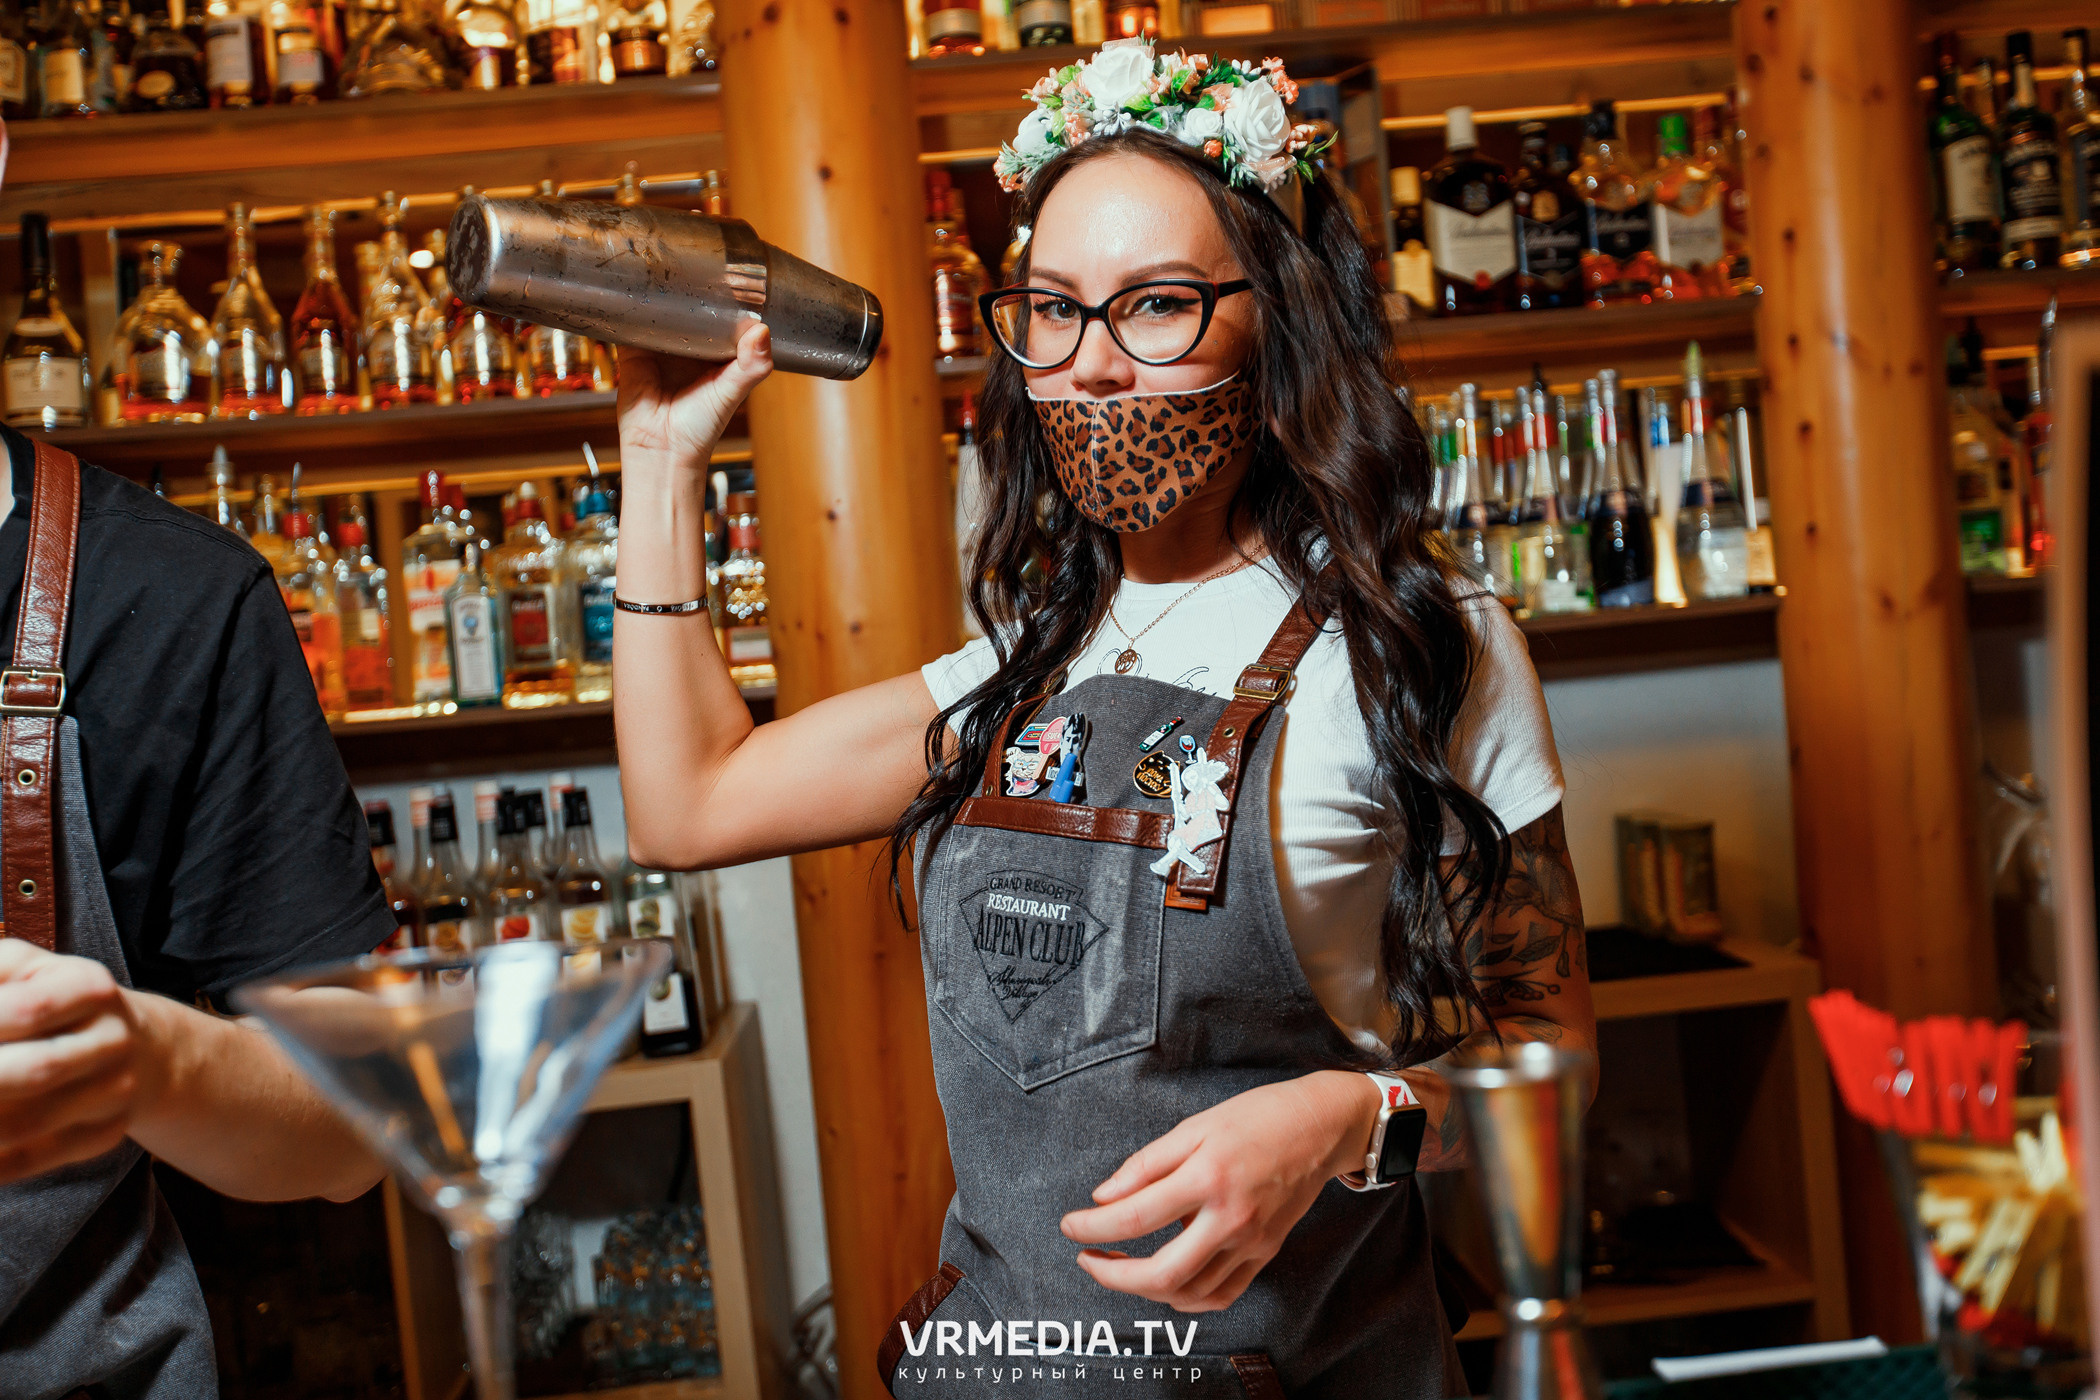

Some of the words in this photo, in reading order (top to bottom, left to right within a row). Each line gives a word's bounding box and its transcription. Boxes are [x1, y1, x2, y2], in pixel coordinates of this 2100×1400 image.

[990, 877, 1022, 891] GRAND
[1024, 878, 1077, 903] RESORT
[987, 893, 1071, 921] RESTAURANT
[975, 904, 1028, 959] ALPEN
[1029, 921, 1086, 966] CLUB
